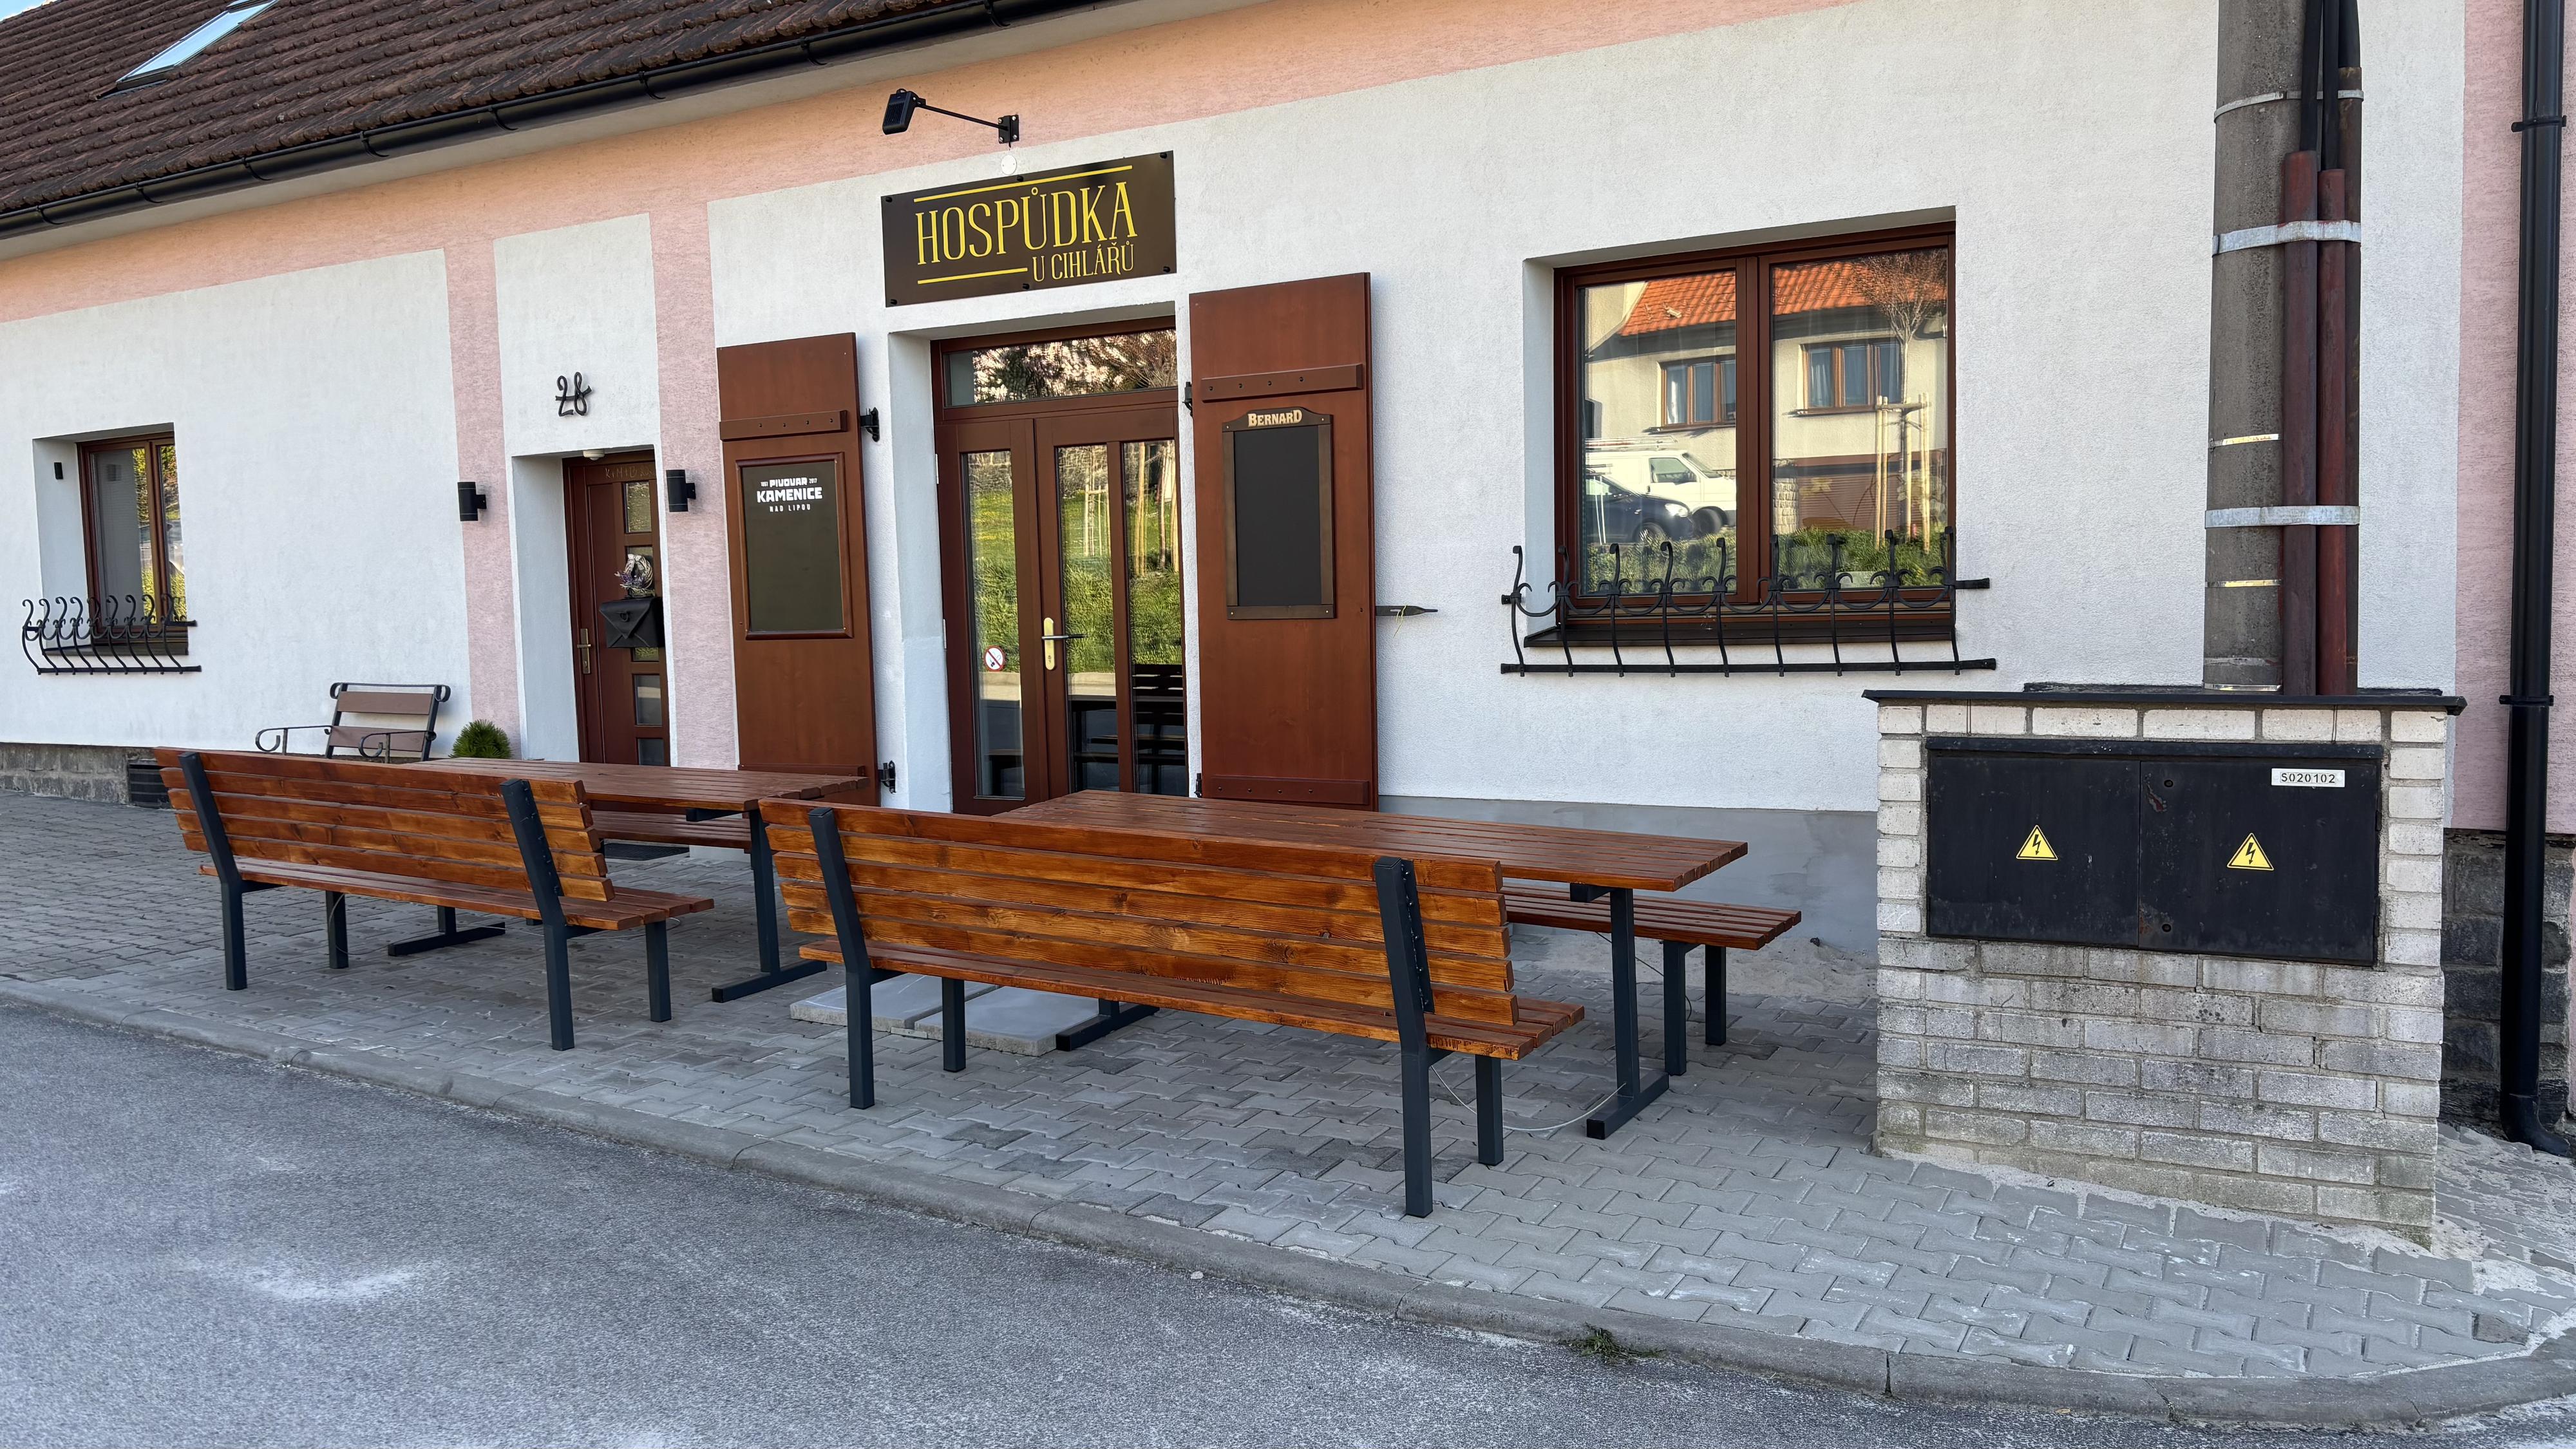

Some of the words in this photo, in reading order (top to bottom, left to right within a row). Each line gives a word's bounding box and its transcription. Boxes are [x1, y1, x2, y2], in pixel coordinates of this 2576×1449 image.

[915, 182, 1138, 265] HOSPŮDKA
[1032, 255, 1045, 281] U
[1051, 240, 1134, 279] CIHLÁŘŮ
[1247, 409, 1302, 427] BERNARD
[770, 477, 808, 487] PIVOVAR
[757, 487, 822, 503] KAMENICE
